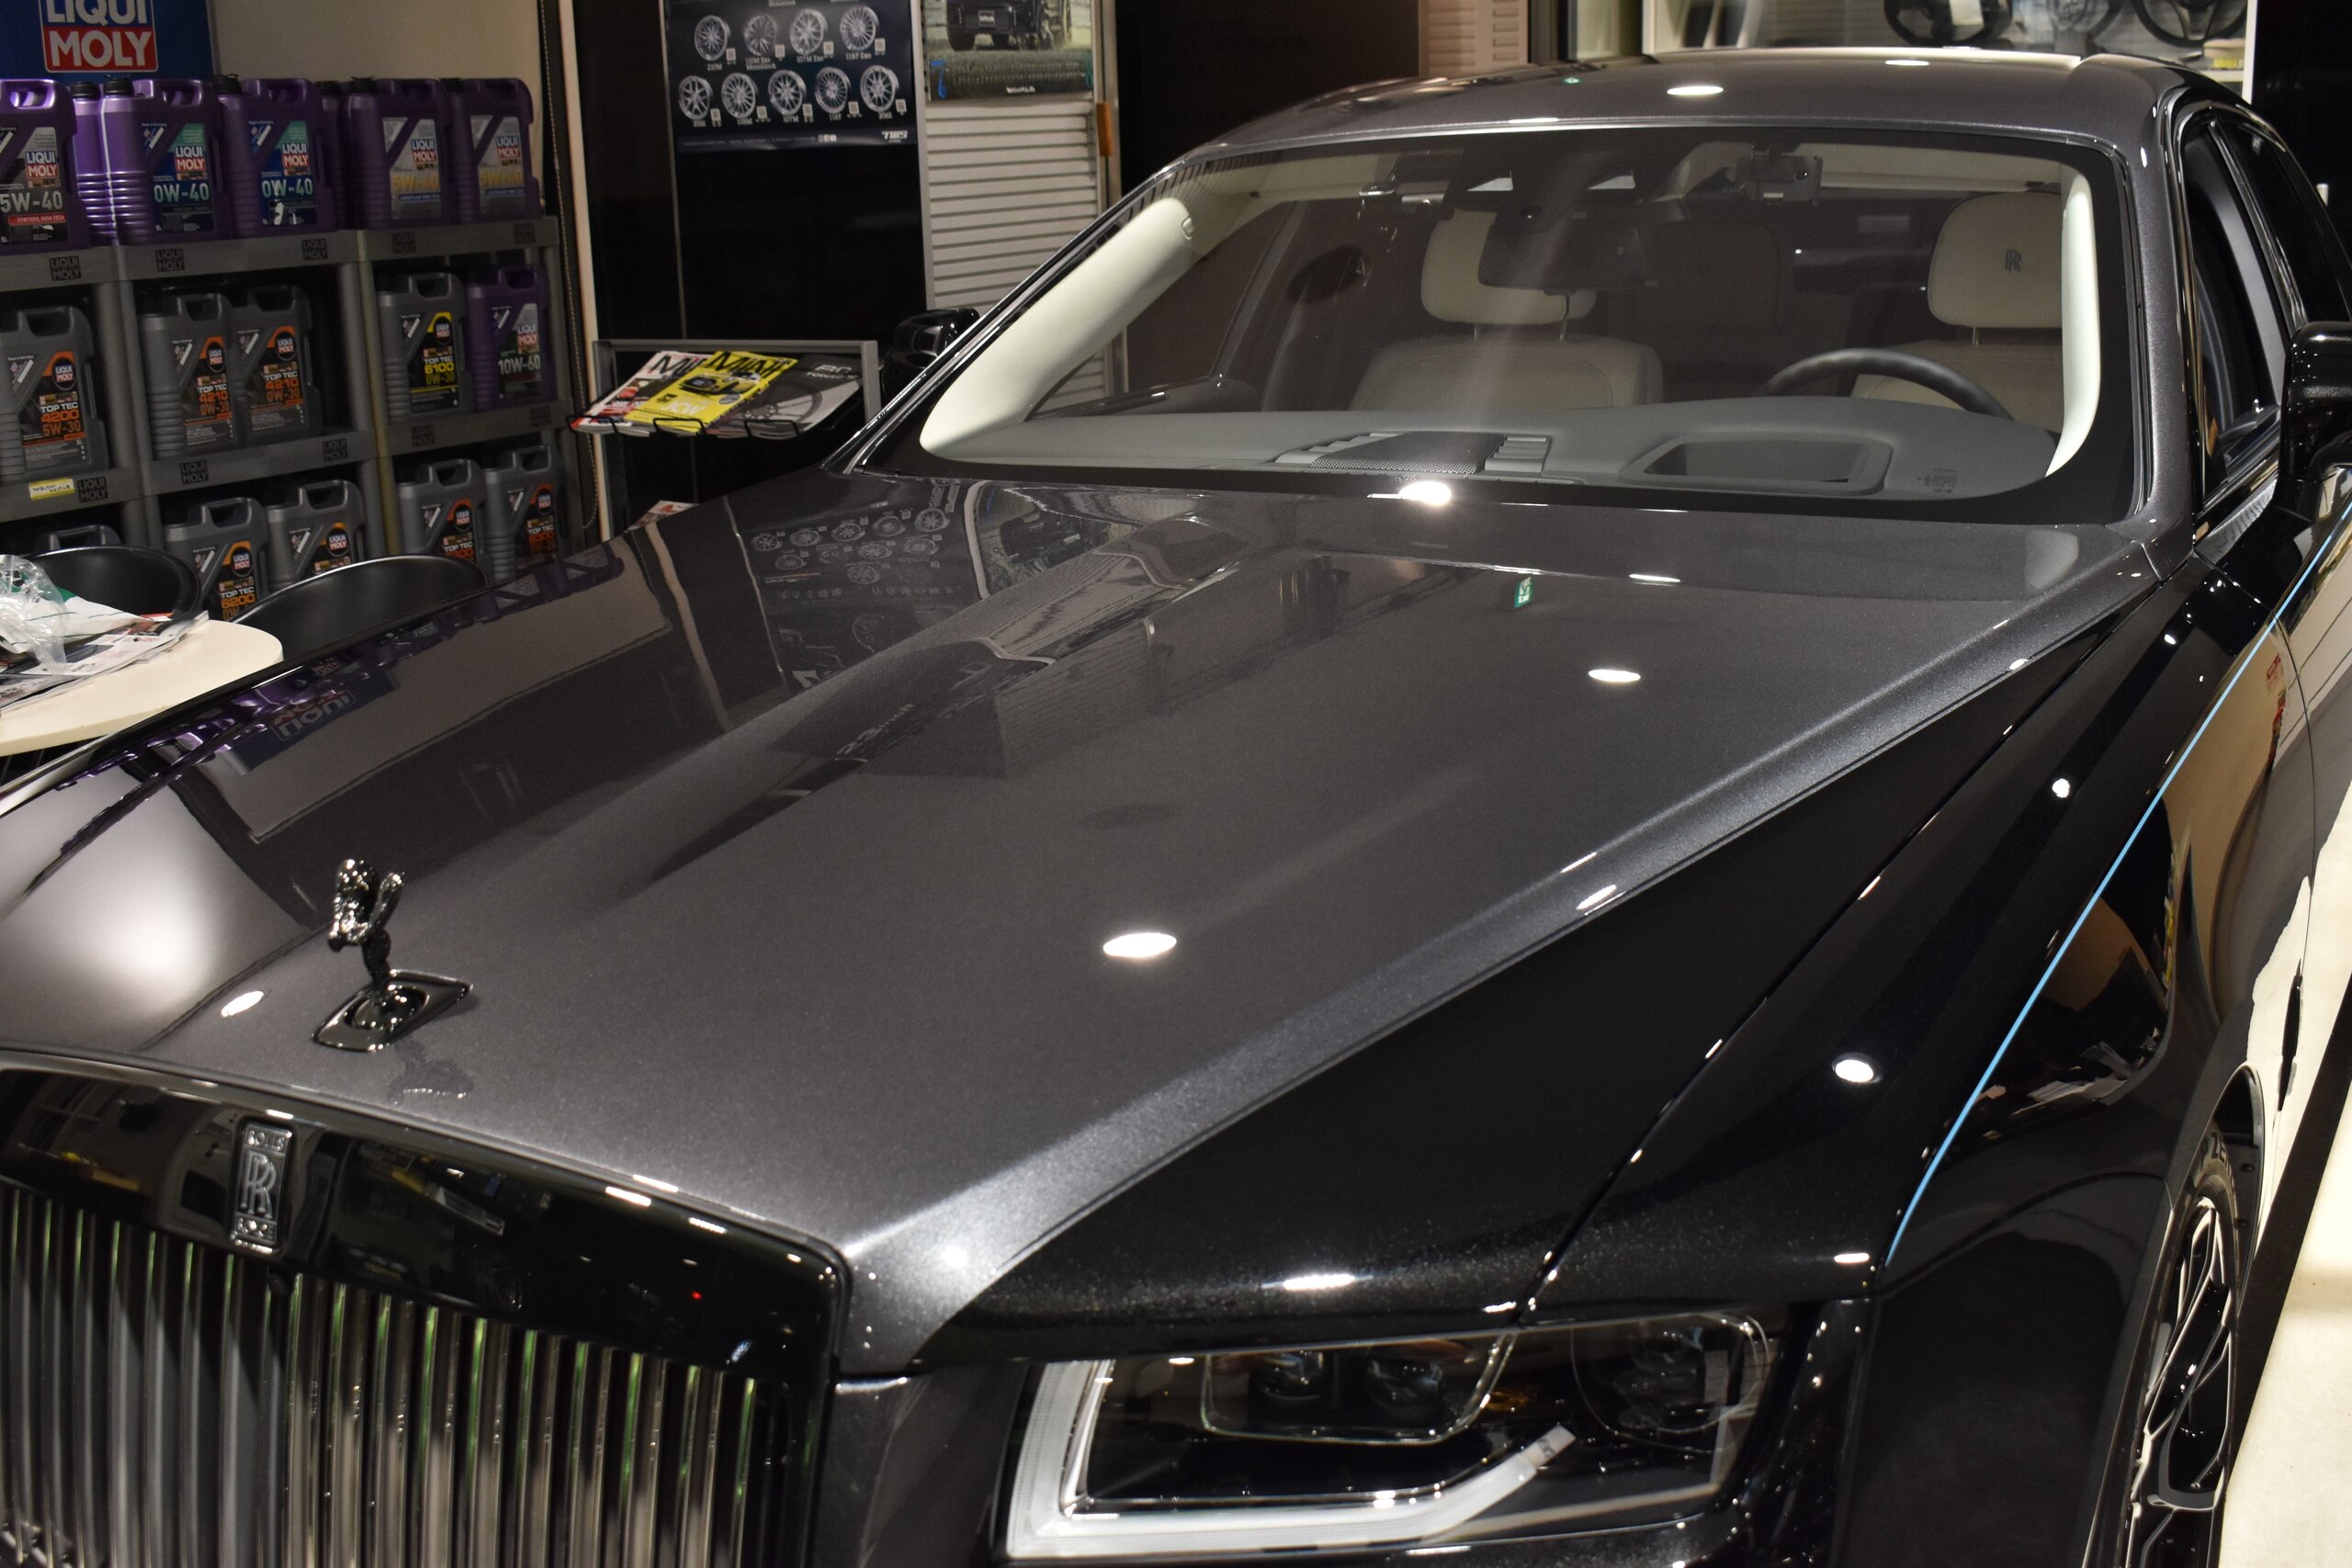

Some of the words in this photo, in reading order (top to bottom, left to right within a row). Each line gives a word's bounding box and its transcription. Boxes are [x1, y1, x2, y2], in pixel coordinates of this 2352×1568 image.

[46, 0, 147, 27] LIQUI
[49, 30, 152, 67] MOLY
[282, 142, 308, 154] LIQUI
[411, 139, 435, 151] LIQUI
[496, 136, 520, 148] LIQUI
[27, 151, 57, 164] LIQUI
[175, 146, 204, 158] LIQUI
[412, 150, 437, 163] MOLY
[497, 147, 522, 159] MOLY
[175, 157, 206, 171] MOLY
[283, 154, 310, 167] MOLY
[28, 164, 59, 178] MOLY
[153, 182, 210, 203] 0W-40
[261, 177, 313, 198] 0W-40
[156, 249, 183, 261] LIQUI
[51, 256, 80, 269] LIQUI
[158, 260, 185, 272] MOLY
[52, 268, 81, 280] MOLY
[516, 323, 537, 334] LIQUI
[517, 334, 538, 346] MOLY
[54, 364, 74, 374] LIQUI
[424, 362, 455, 375] 6100
[498, 354, 541, 376] 10W-60
[703, 352, 788, 379] MINI
[56, 372, 75, 383] MOLY
[40, 404, 61, 412] TOP
[61, 401, 80, 410] TEC
[40, 409, 80, 423] 4200
[42, 420, 82, 436] 5W-30
[323, 438, 347, 451] LIQUI
[324, 450, 349, 462] MOLY
[180, 461, 206, 472] LIQUI
[182, 471, 209, 483] MOLY
[79, 478, 106, 490] LIQUI
[80, 489, 108, 502] MOLY
[541, 525, 555, 533] TEC
[329, 535, 346, 544] LIQUI
[330, 541, 348, 551] MOLY
[458, 542, 474, 550] TEC
[232, 554, 250, 563] LIQUI
[233, 560, 251, 570] MOLY
[237, 587, 255, 595] TEC
[221, 593, 256, 609] 6200
